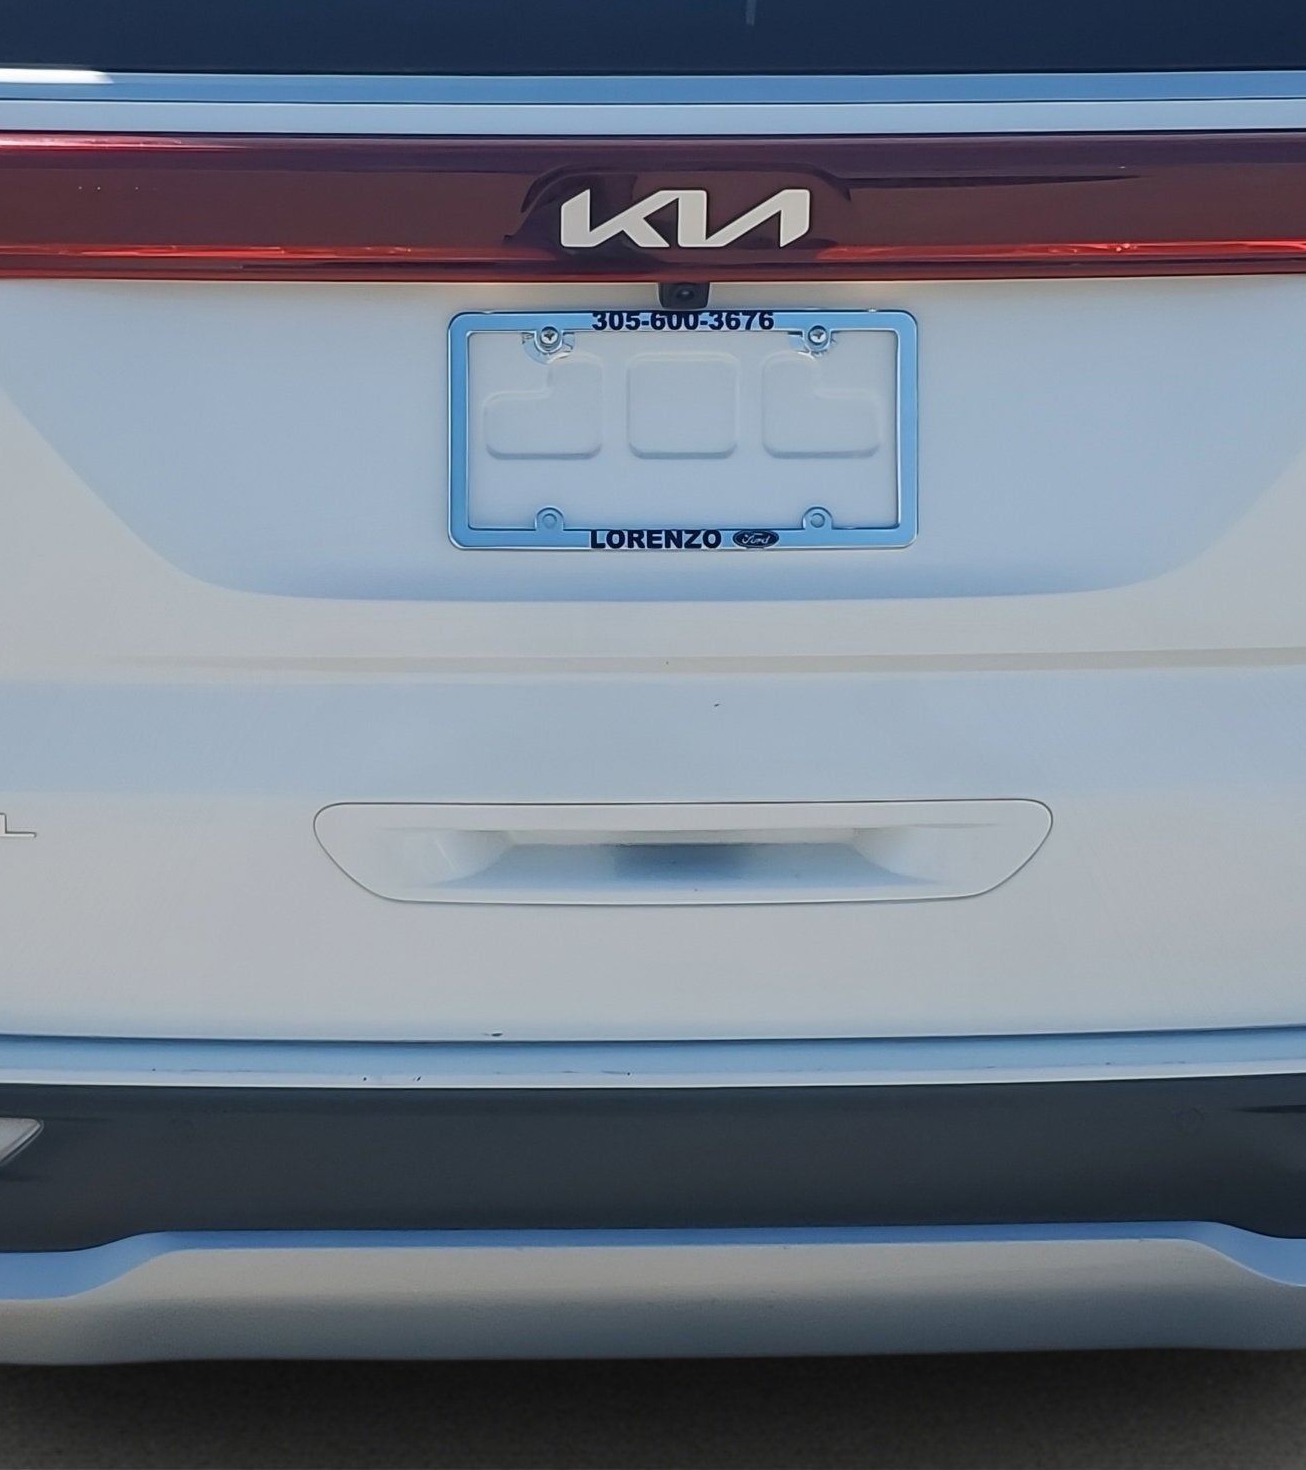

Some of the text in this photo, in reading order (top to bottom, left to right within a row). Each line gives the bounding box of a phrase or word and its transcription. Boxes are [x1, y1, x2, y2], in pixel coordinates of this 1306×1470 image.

[560, 188, 810, 248] KIA
[592, 311, 775, 331] 305-600-3676
[590, 529, 722, 549] LORENZO
